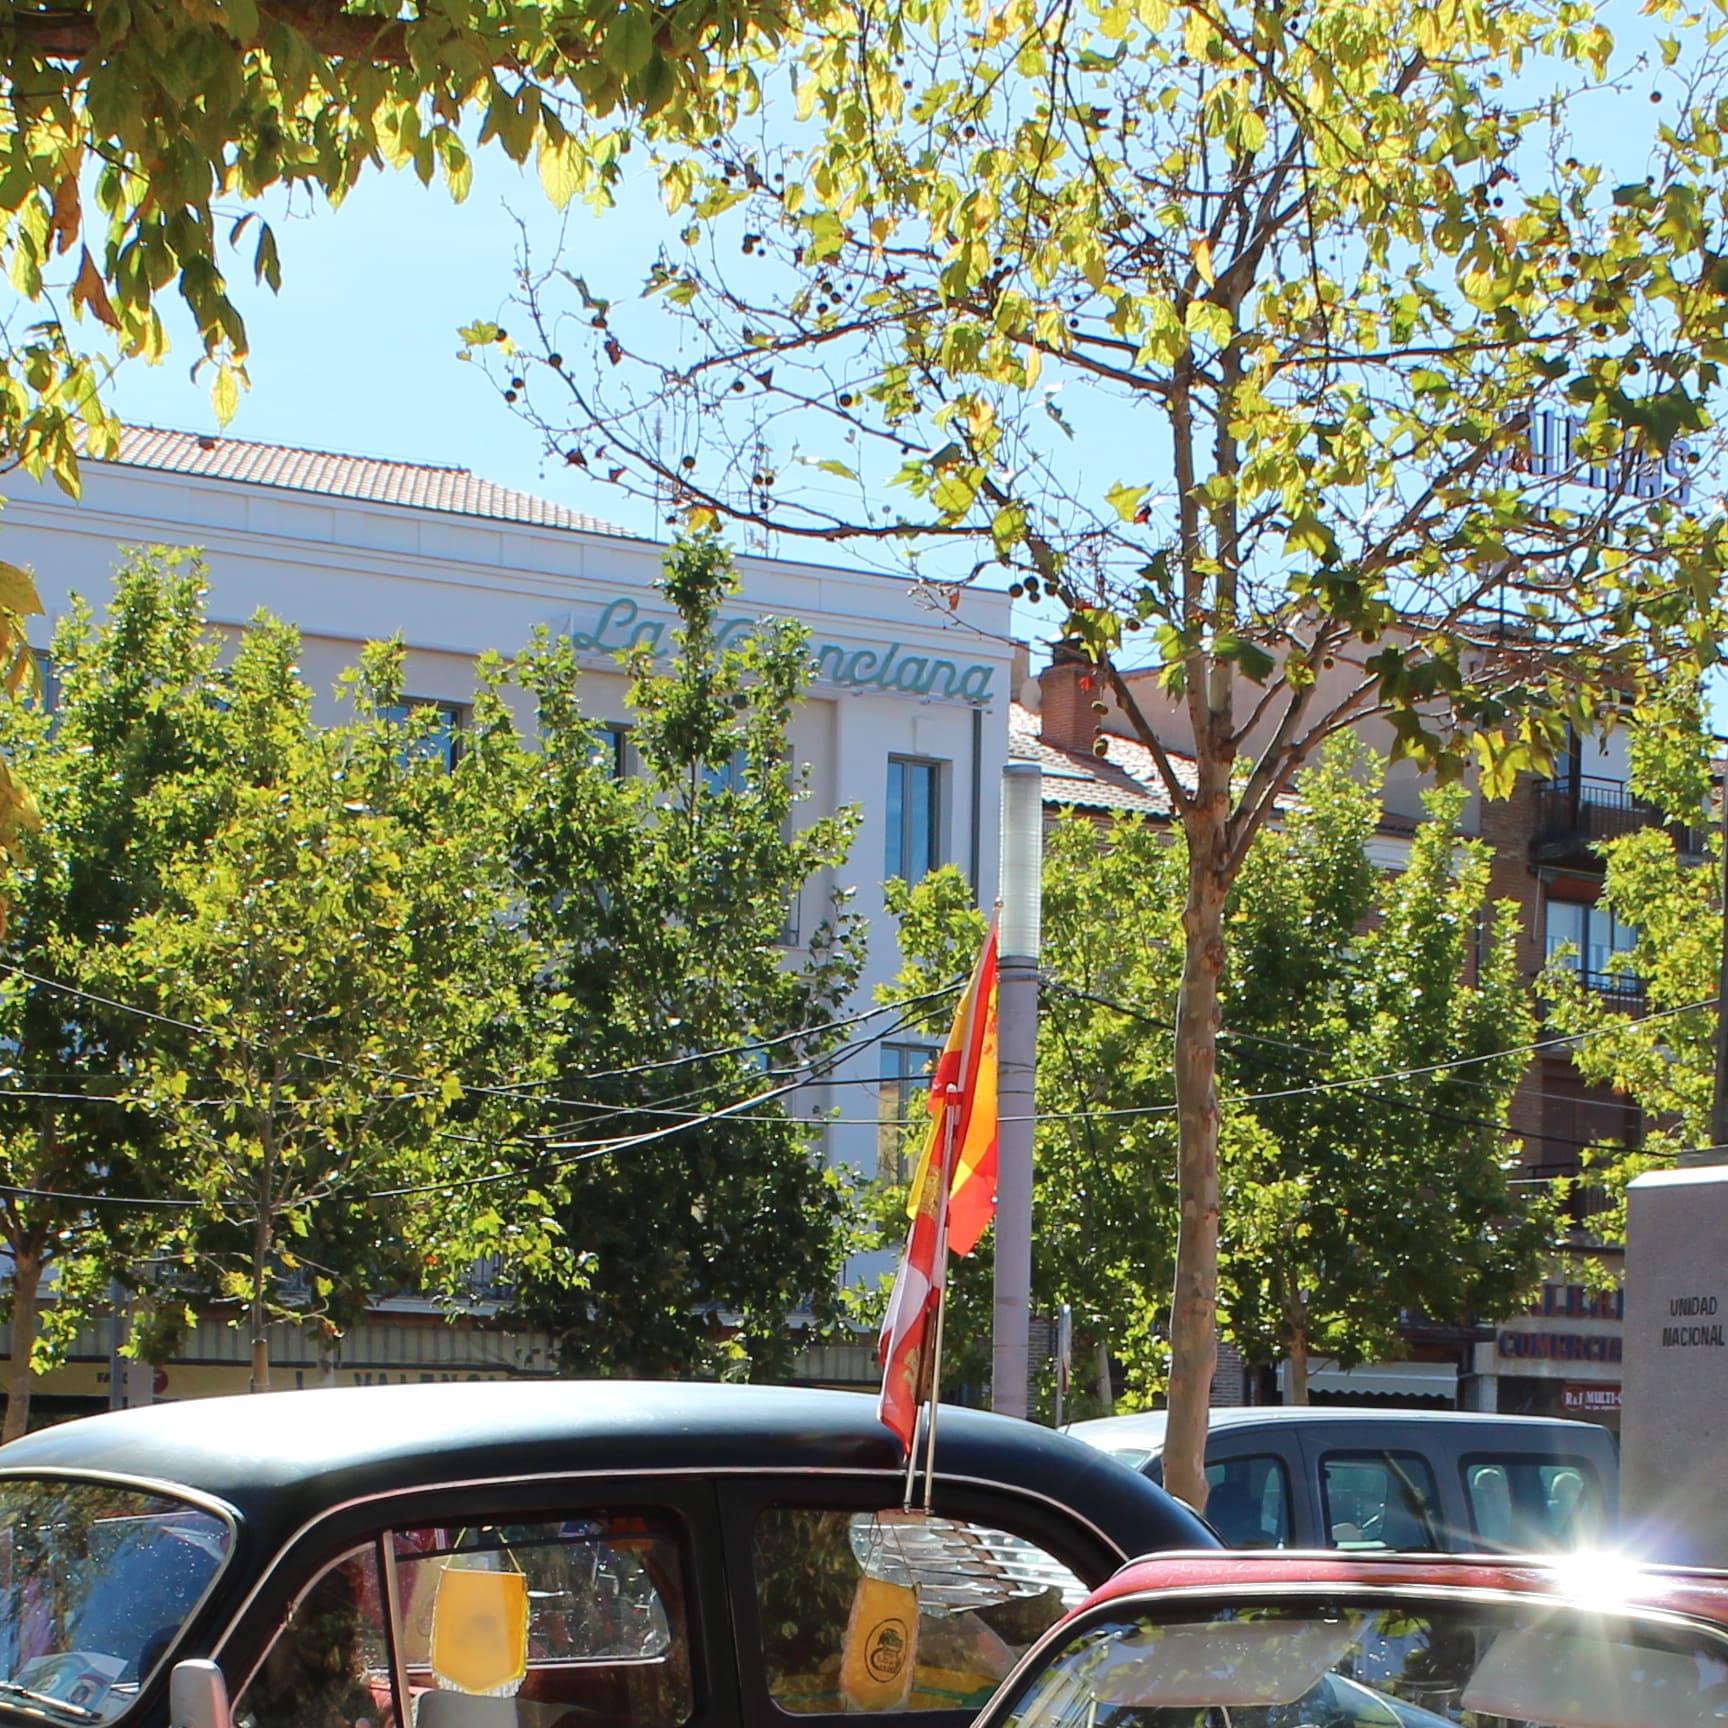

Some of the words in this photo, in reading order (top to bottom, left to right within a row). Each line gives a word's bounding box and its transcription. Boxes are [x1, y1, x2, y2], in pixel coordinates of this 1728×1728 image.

[572, 597, 668, 657] La
[1670, 1296, 1718, 1317] UNIDAD
[1662, 1325, 1726, 1347] NACIONAL
